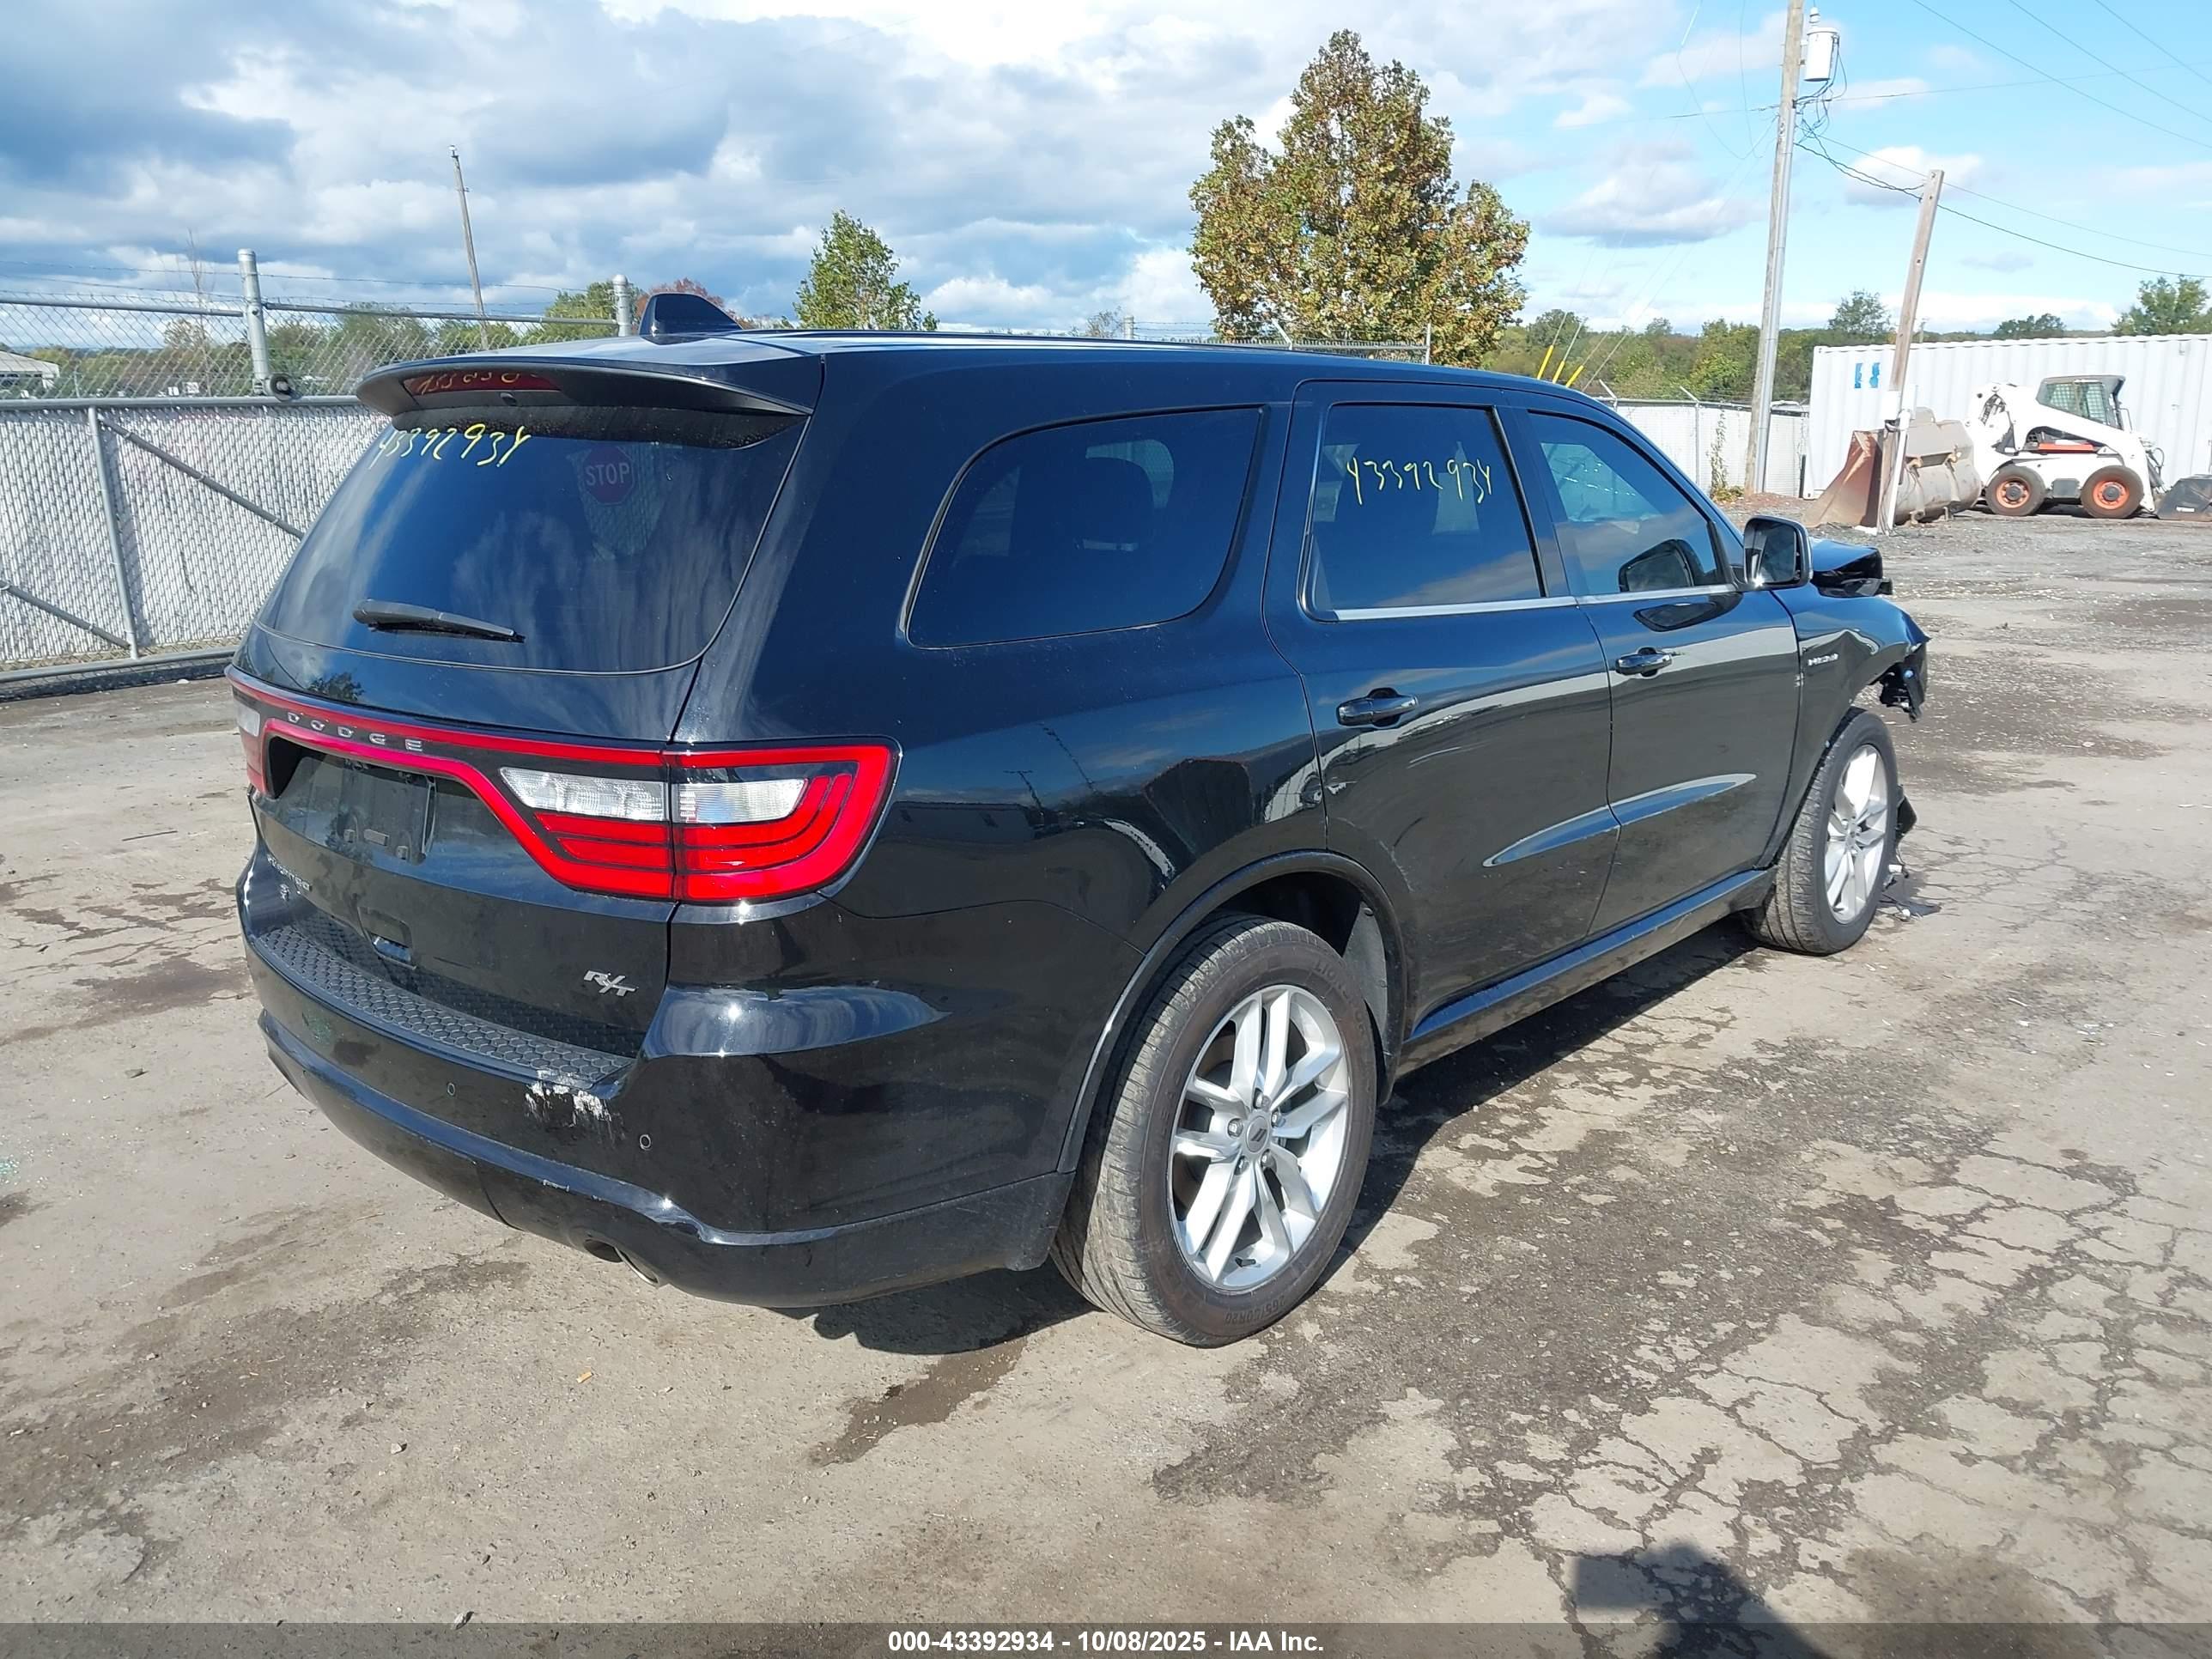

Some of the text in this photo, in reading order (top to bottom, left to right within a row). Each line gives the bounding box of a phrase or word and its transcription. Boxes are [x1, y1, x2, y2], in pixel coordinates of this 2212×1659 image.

[585, 462, 630, 487] STOP
[1346, 457, 1492, 505] 43392934
[288, 712, 423, 752] DODGE
[584, 970, 638, 996] R/T
